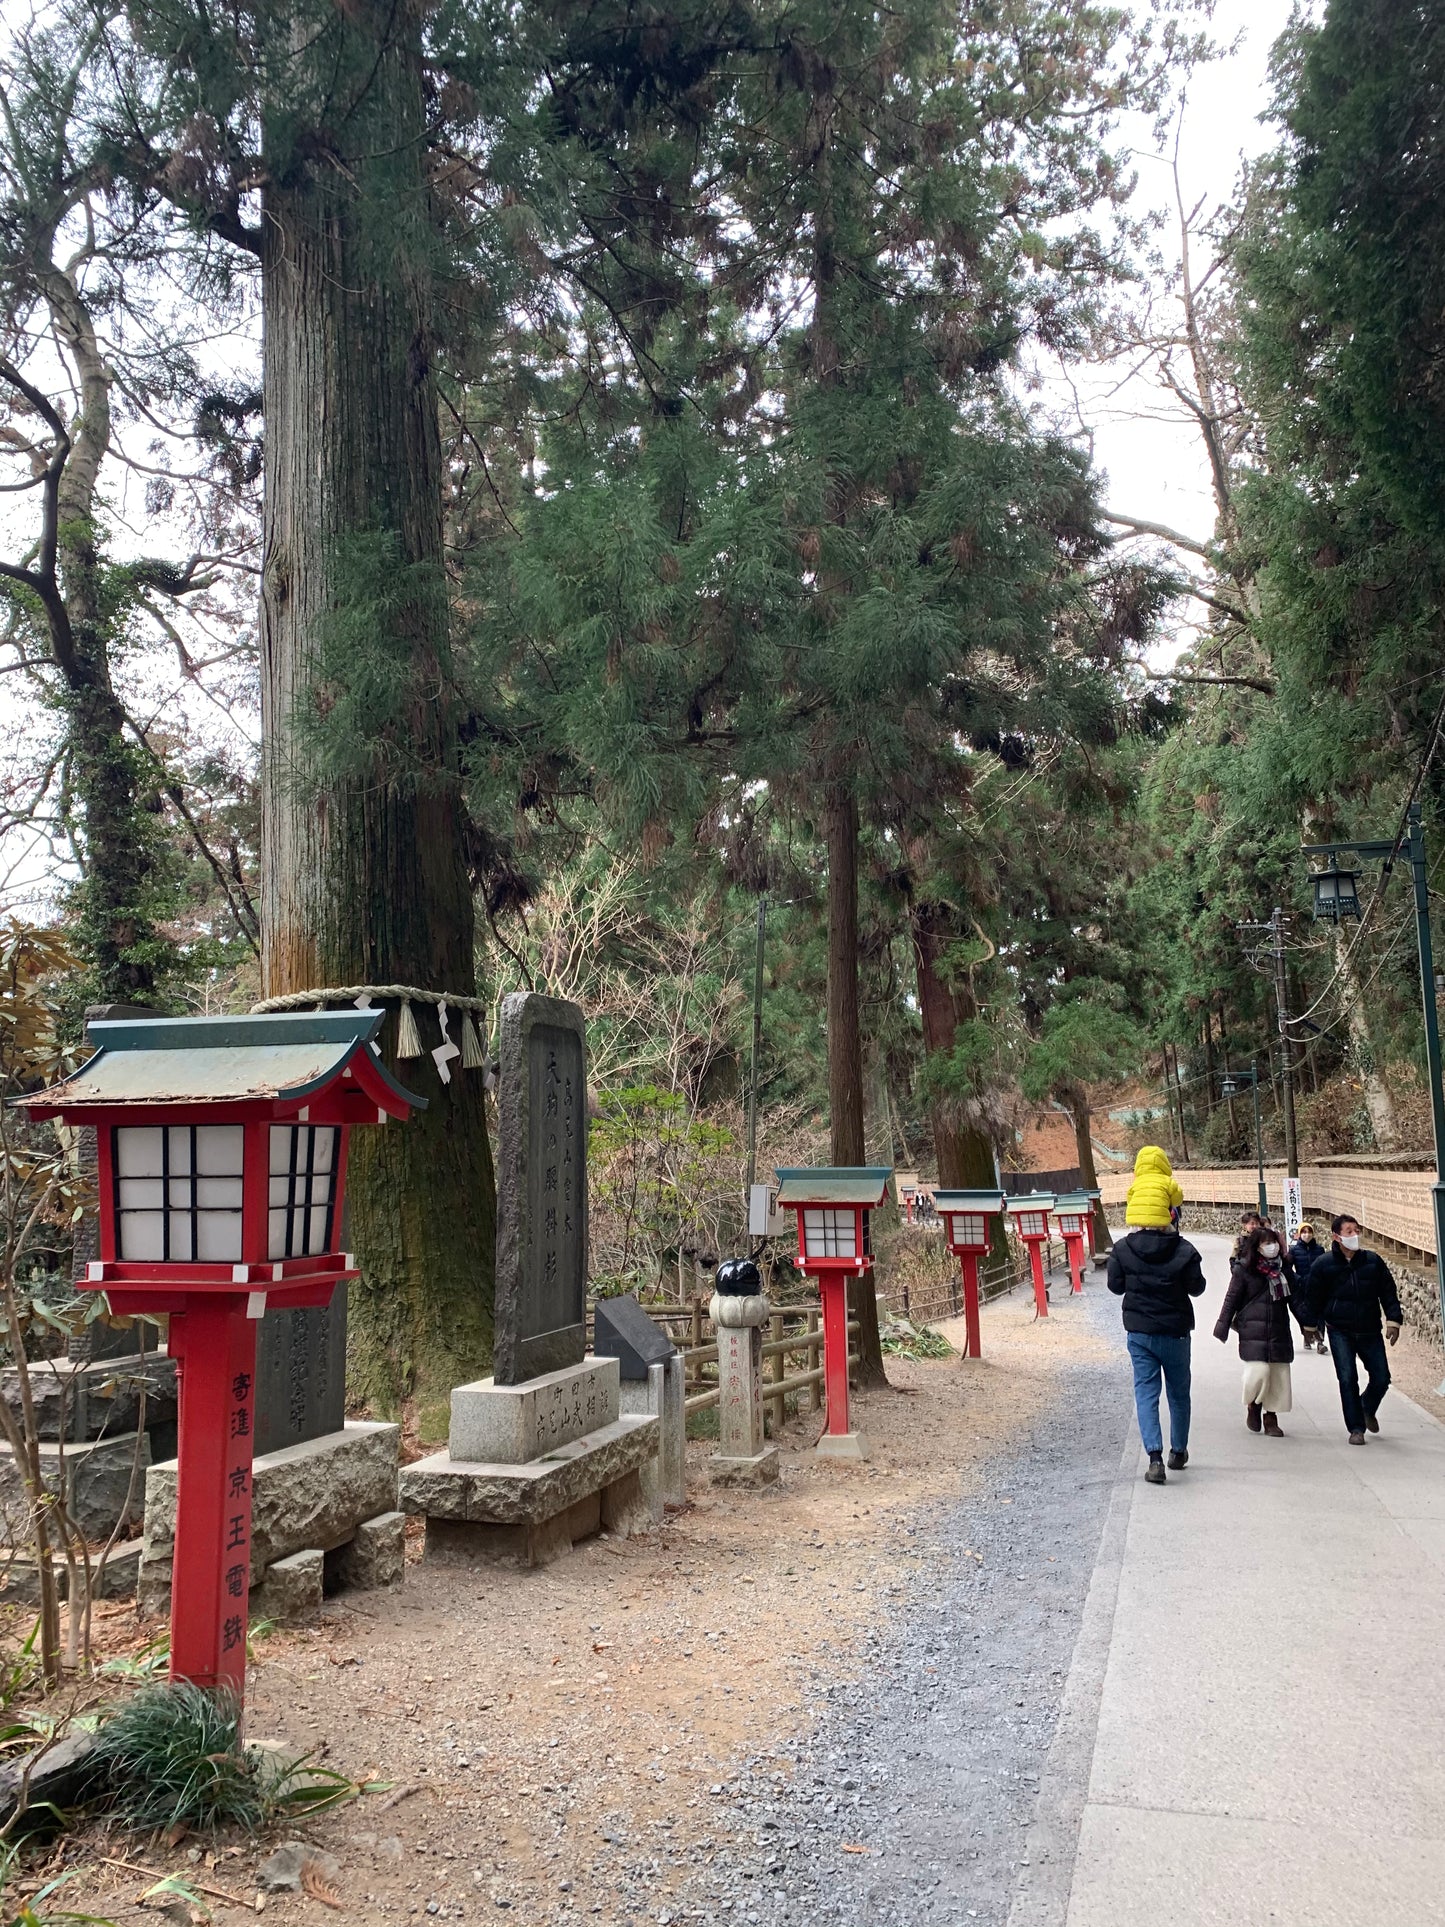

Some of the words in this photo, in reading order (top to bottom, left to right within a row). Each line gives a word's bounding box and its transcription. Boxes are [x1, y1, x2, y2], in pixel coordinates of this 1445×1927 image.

[1289, 1188, 1297, 1225] 天狗うちわ
[222, 1466, 249, 1653] 京王電鉄
